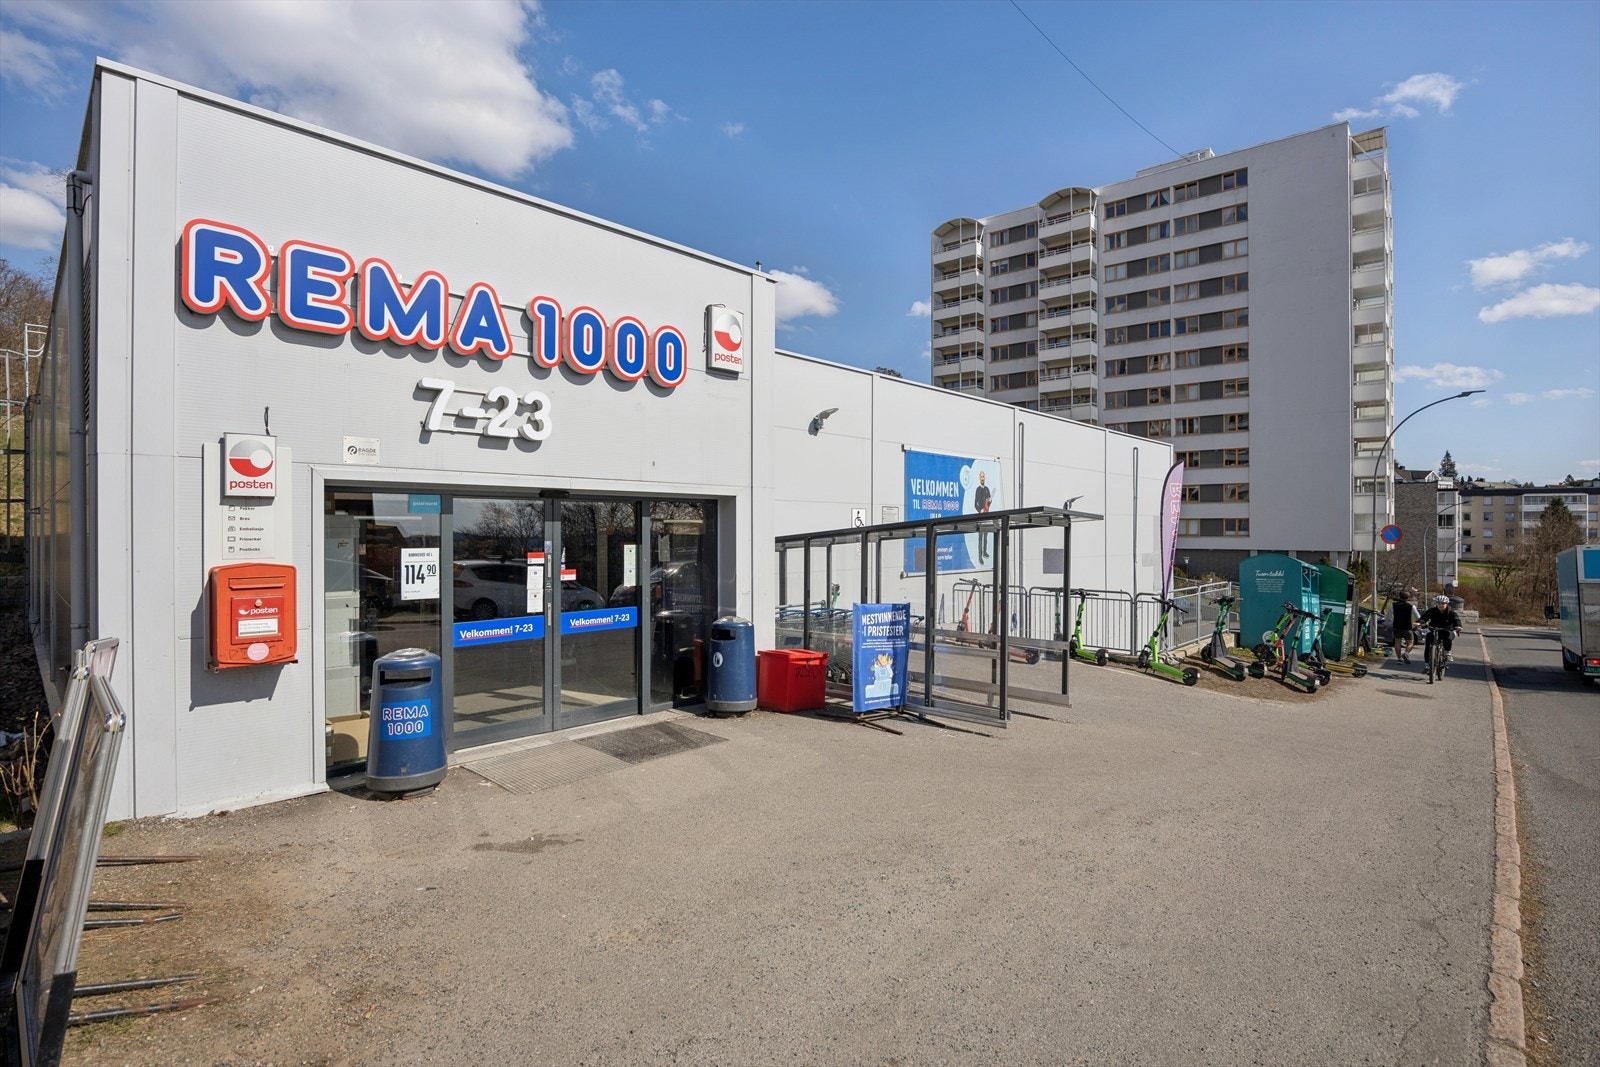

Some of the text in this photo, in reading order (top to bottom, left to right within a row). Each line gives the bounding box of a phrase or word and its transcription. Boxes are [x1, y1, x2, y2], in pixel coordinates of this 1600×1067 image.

[182, 219, 687, 387] REMA 1000
[714, 353, 742, 365] posten
[420, 376, 552, 440] 7-23
[229, 480, 273, 490] posten
[911, 479, 959, 497] VELKOMMEN
[912, 499, 960, 511] TIL REMA 1000
[404, 564, 436, 585] 114 90
[250, 607, 278, 616] posten
[862, 610, 906, 625] MESTVINNENDE
[570, 614, 630, 626] Velkommen! 7-23
[460, 624, 533, 639] Velkommen! 7-23
[868, 626, 904, 636] PRISTESTER
[382, 704, 428, 720] REMA
[388, 720, 424, 736] 1000
